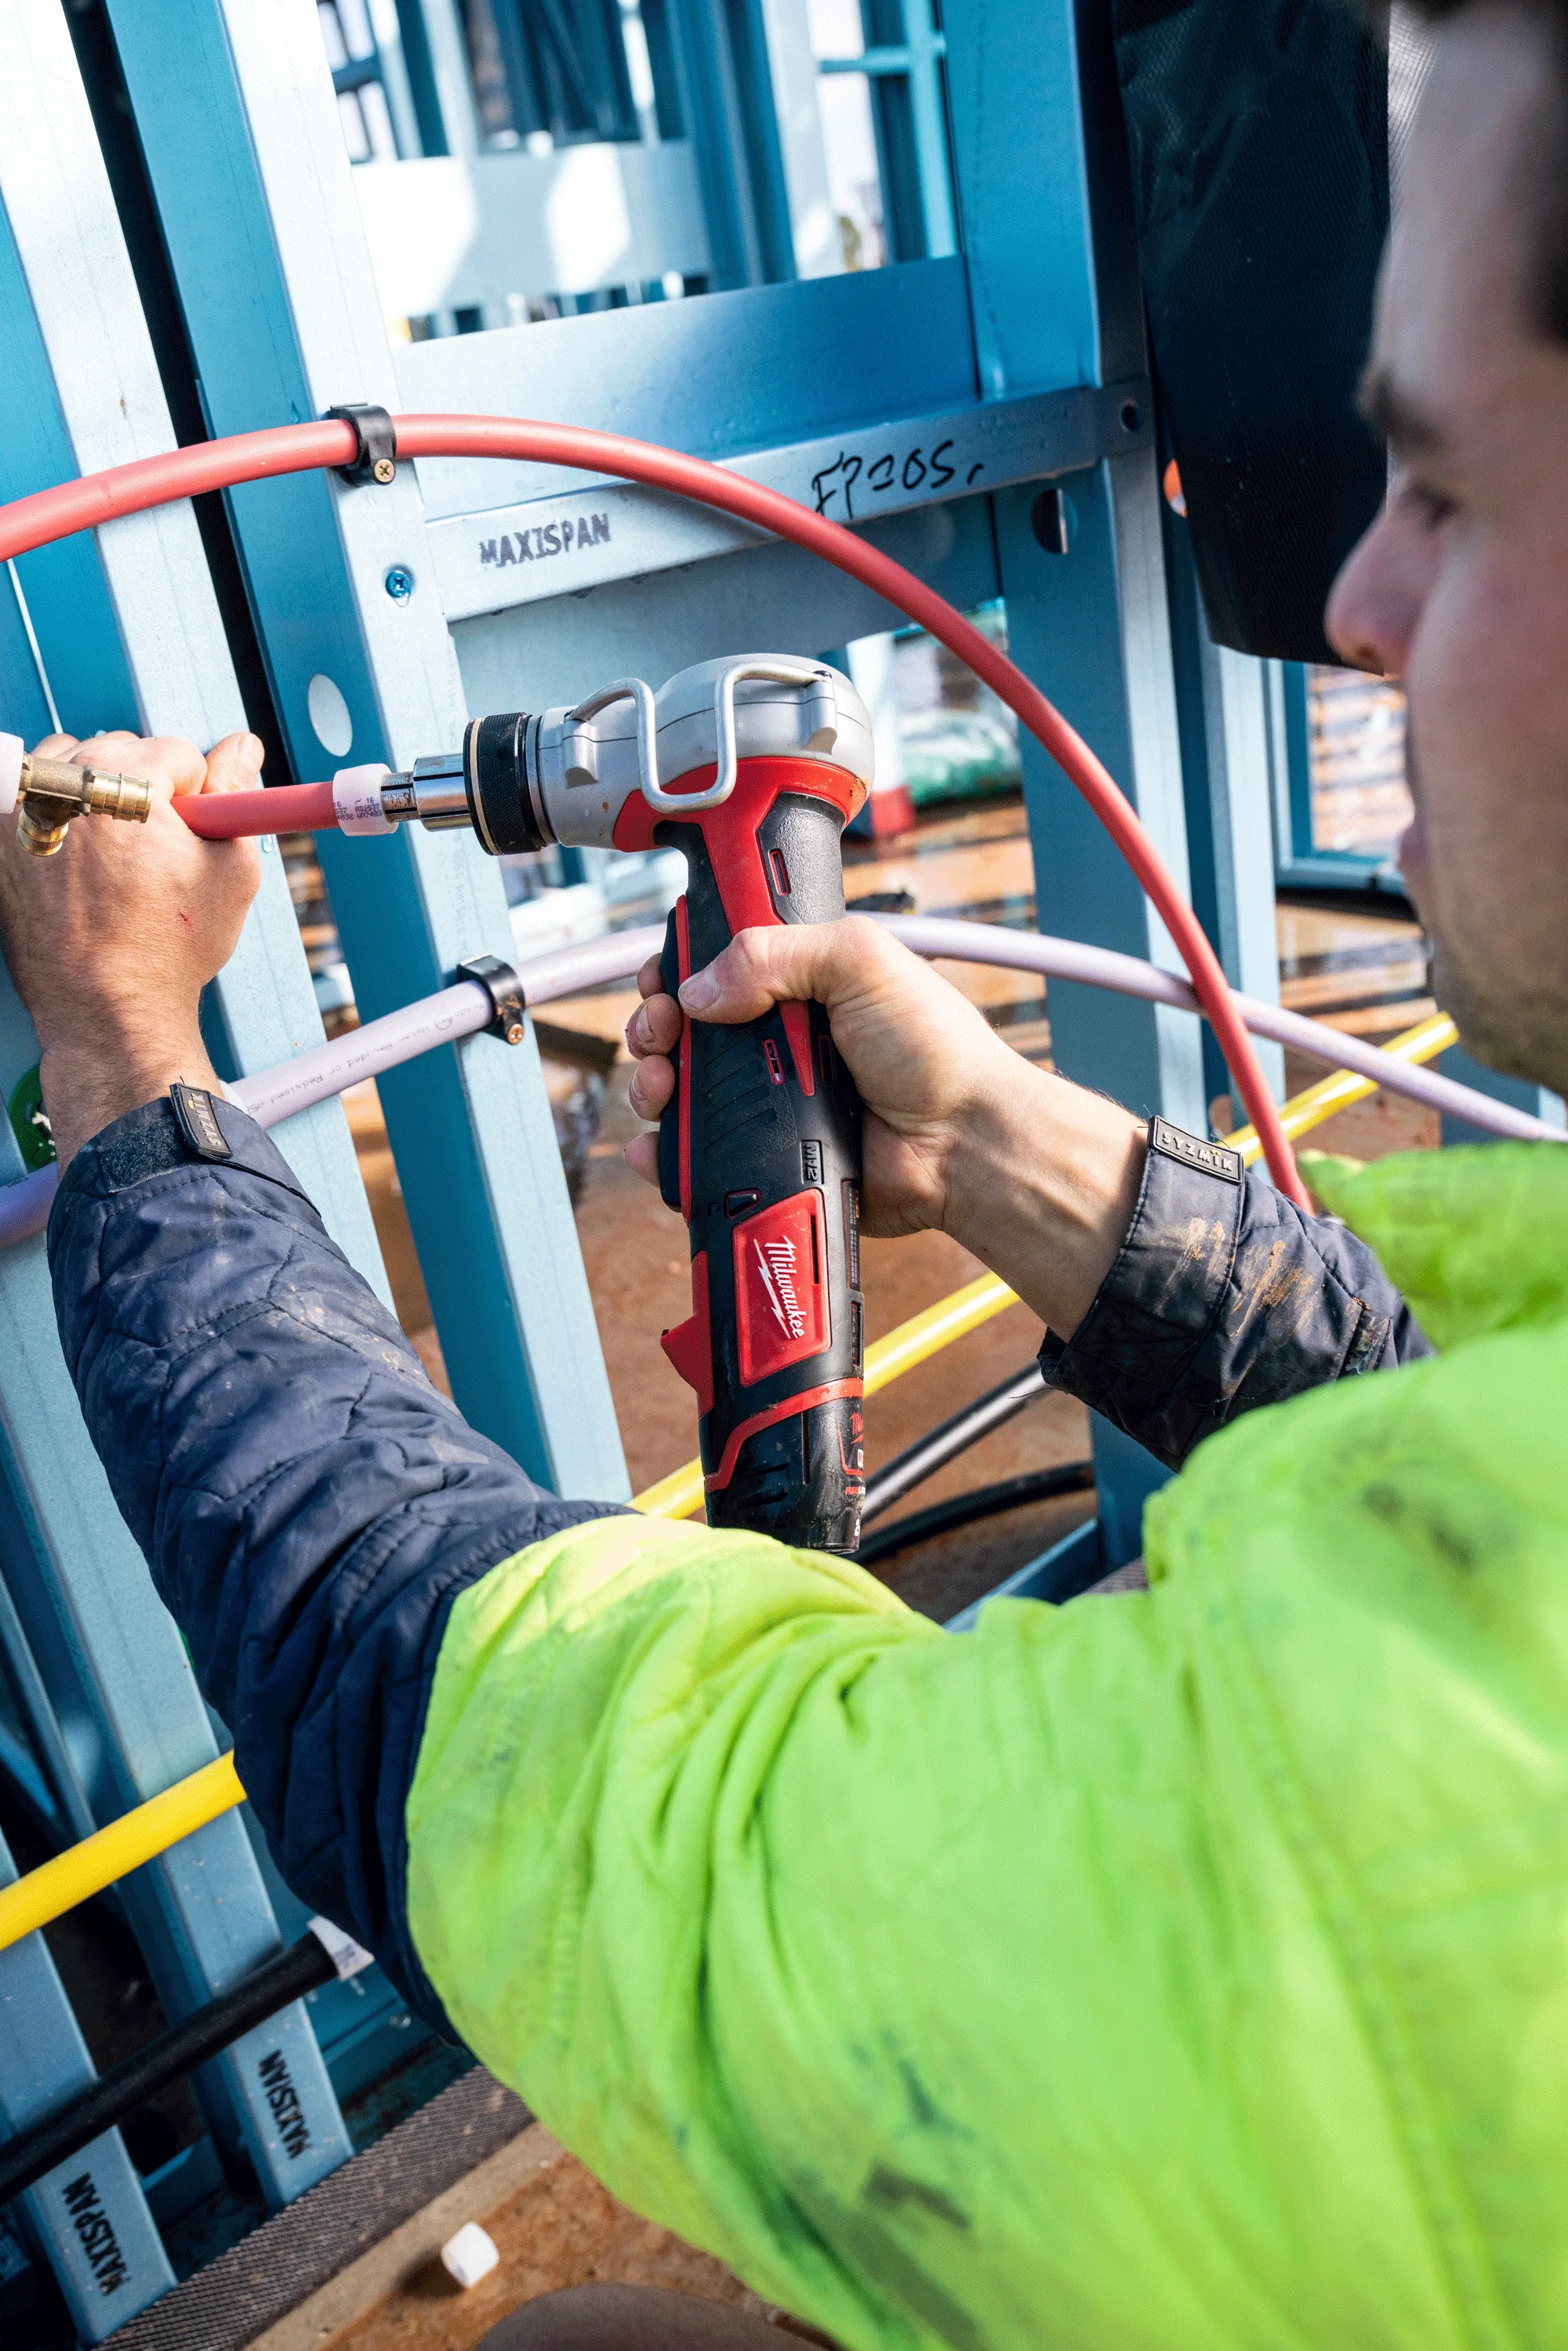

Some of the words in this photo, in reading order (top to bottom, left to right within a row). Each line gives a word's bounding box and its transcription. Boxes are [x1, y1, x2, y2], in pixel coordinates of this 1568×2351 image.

[479, 513, 611, 568] MAXISPAN
[764, 1234, 807, 1339] Milwaukee
[62, 2171, 132, 2297] MAXISPAN
